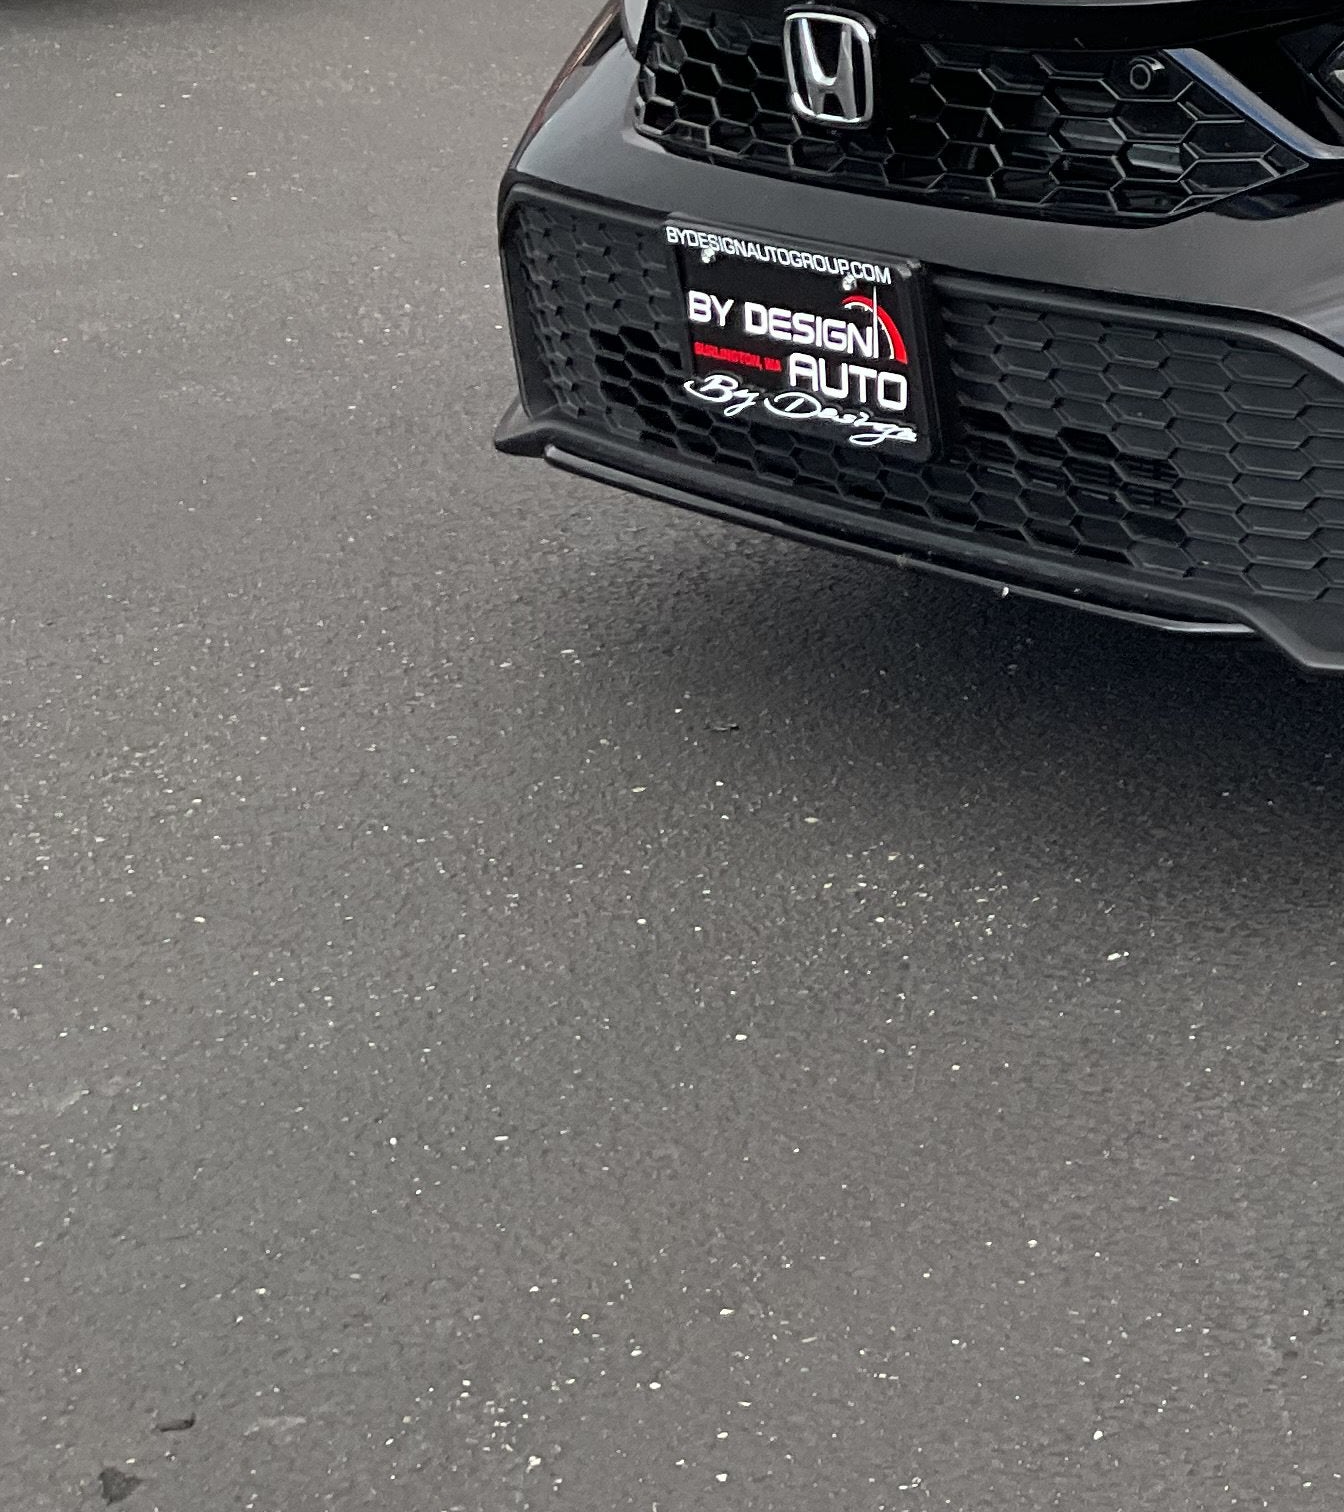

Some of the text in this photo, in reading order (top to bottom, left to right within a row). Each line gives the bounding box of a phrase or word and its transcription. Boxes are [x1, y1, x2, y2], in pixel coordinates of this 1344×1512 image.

[665, 226, 892, 285] BYDESIGNAUTOGROUP.COM
[688, 290, 875, 359] BY DESIGN
[684, 374, 917, 446] By Design
[788, 352, 908, 411] AUTO
